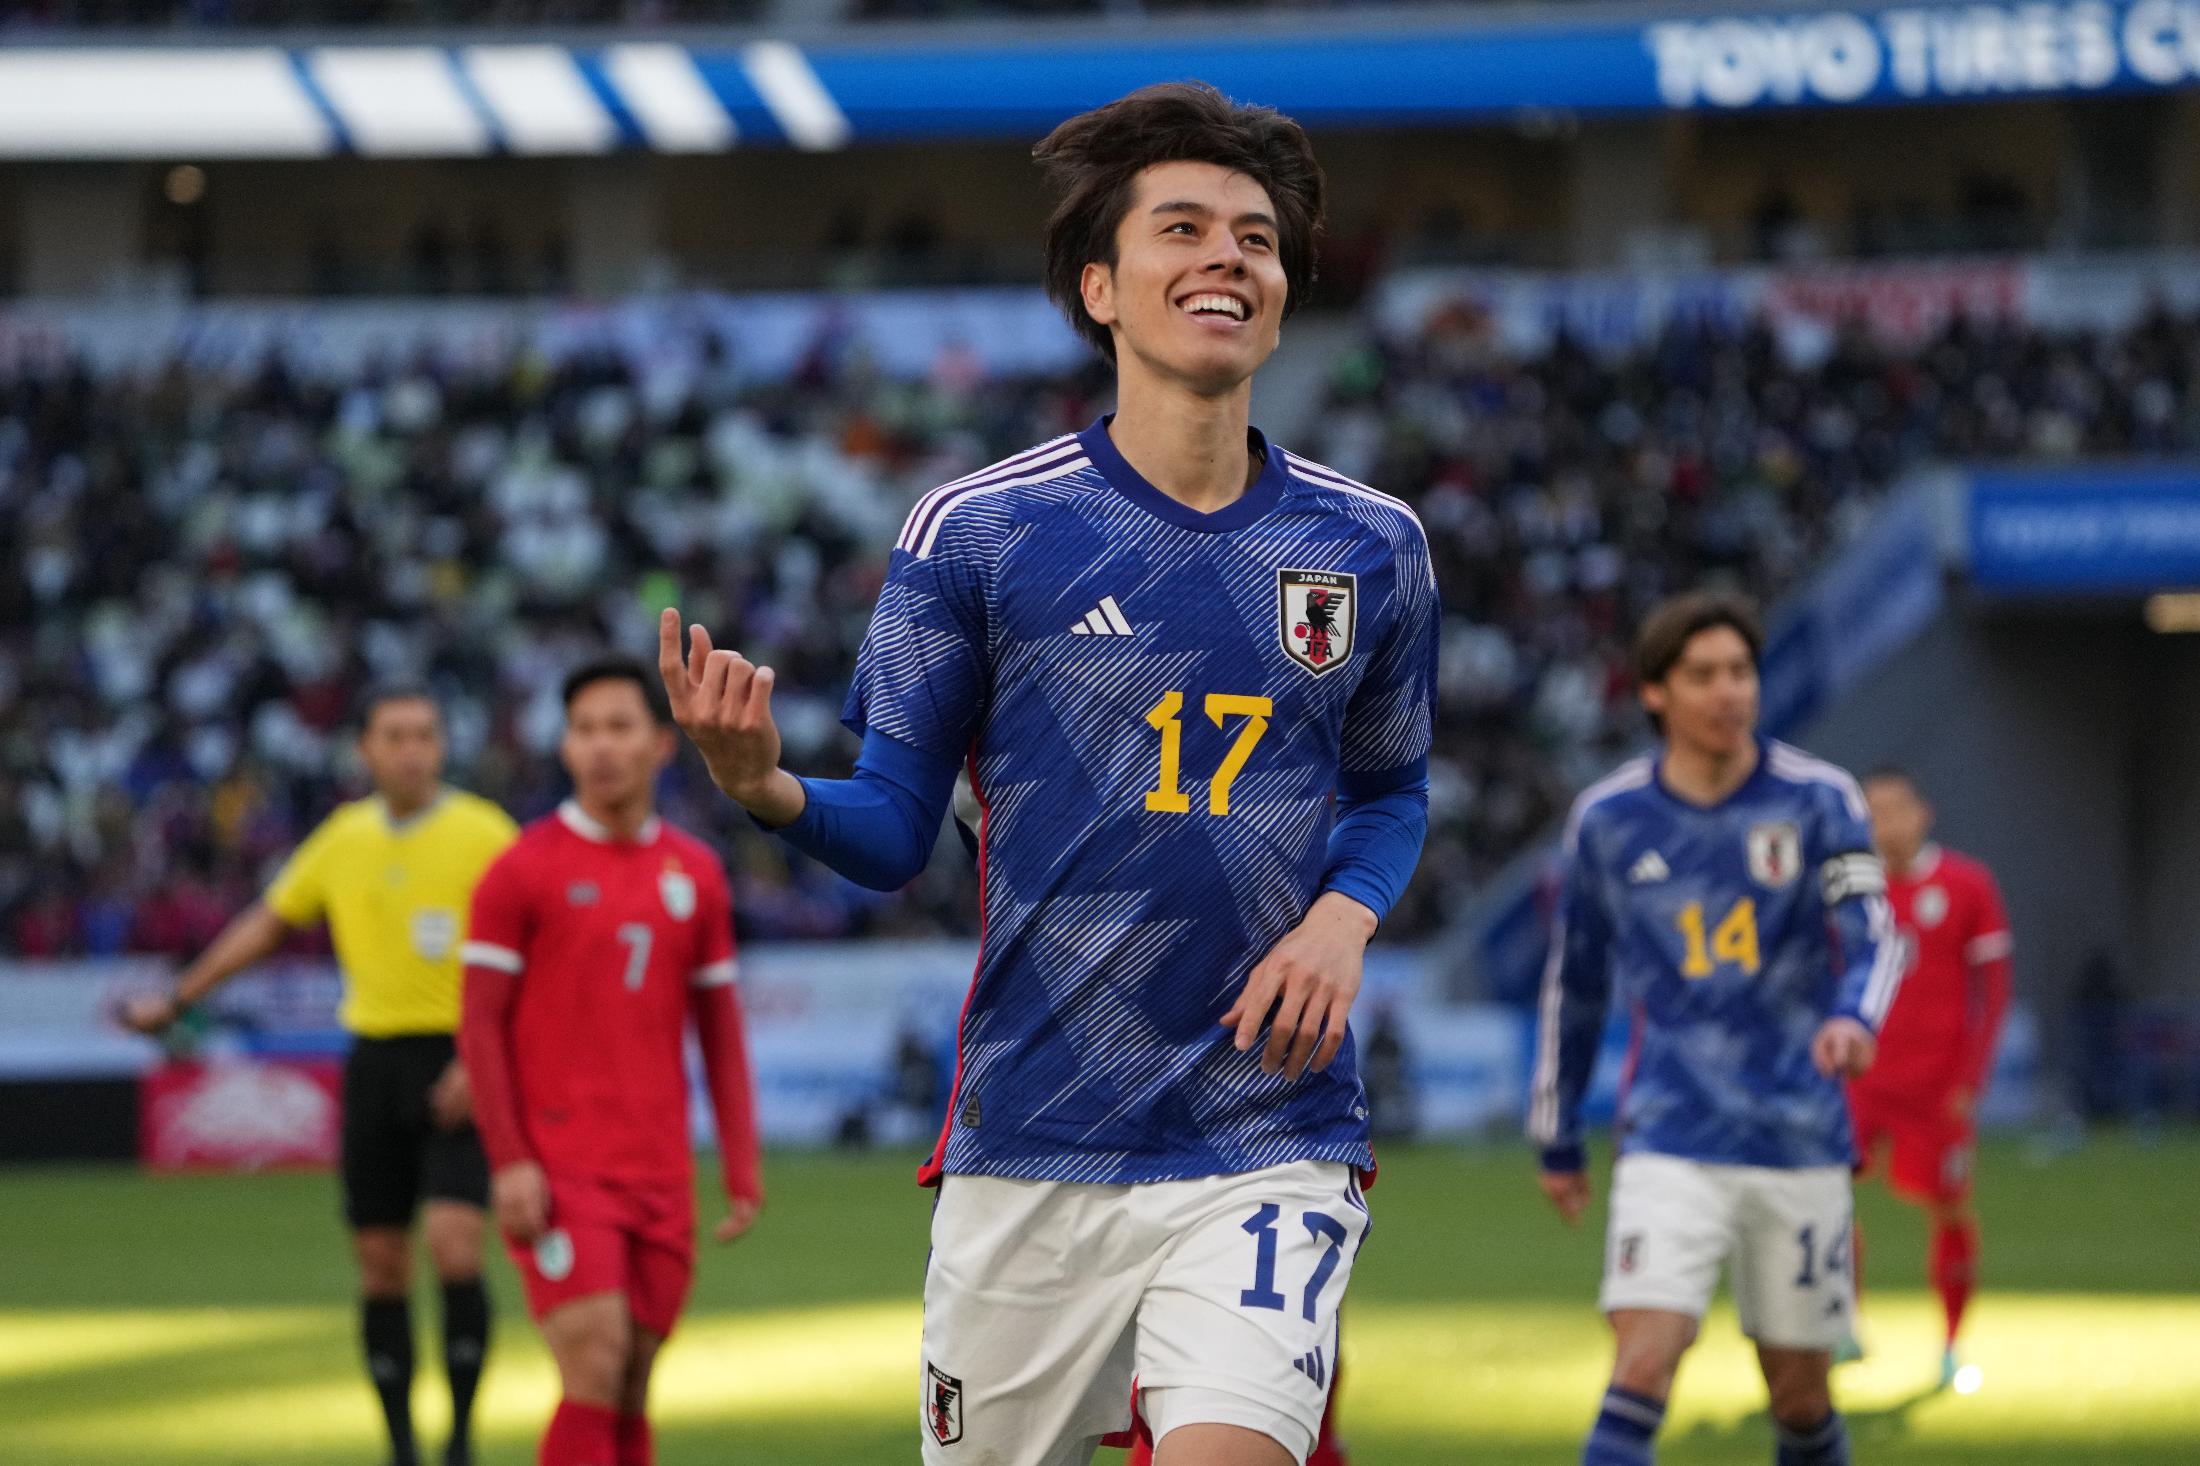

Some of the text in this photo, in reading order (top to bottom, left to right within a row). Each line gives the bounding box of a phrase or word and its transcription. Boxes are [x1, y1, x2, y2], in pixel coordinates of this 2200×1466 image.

[1648, 12, 1880, 107] TOYO
[1888, 2, 2117, 95] TIRES
[1298, 573, 1337, 585] JAPAN
[1301, 640, 1334, 659] JFA
[1145, 690, 1273, 816] 17
[617, 922, 653, 991] 7
[1677, 896, 1761, 978] 14
[1240, 1202, 1348, 1324] 17
